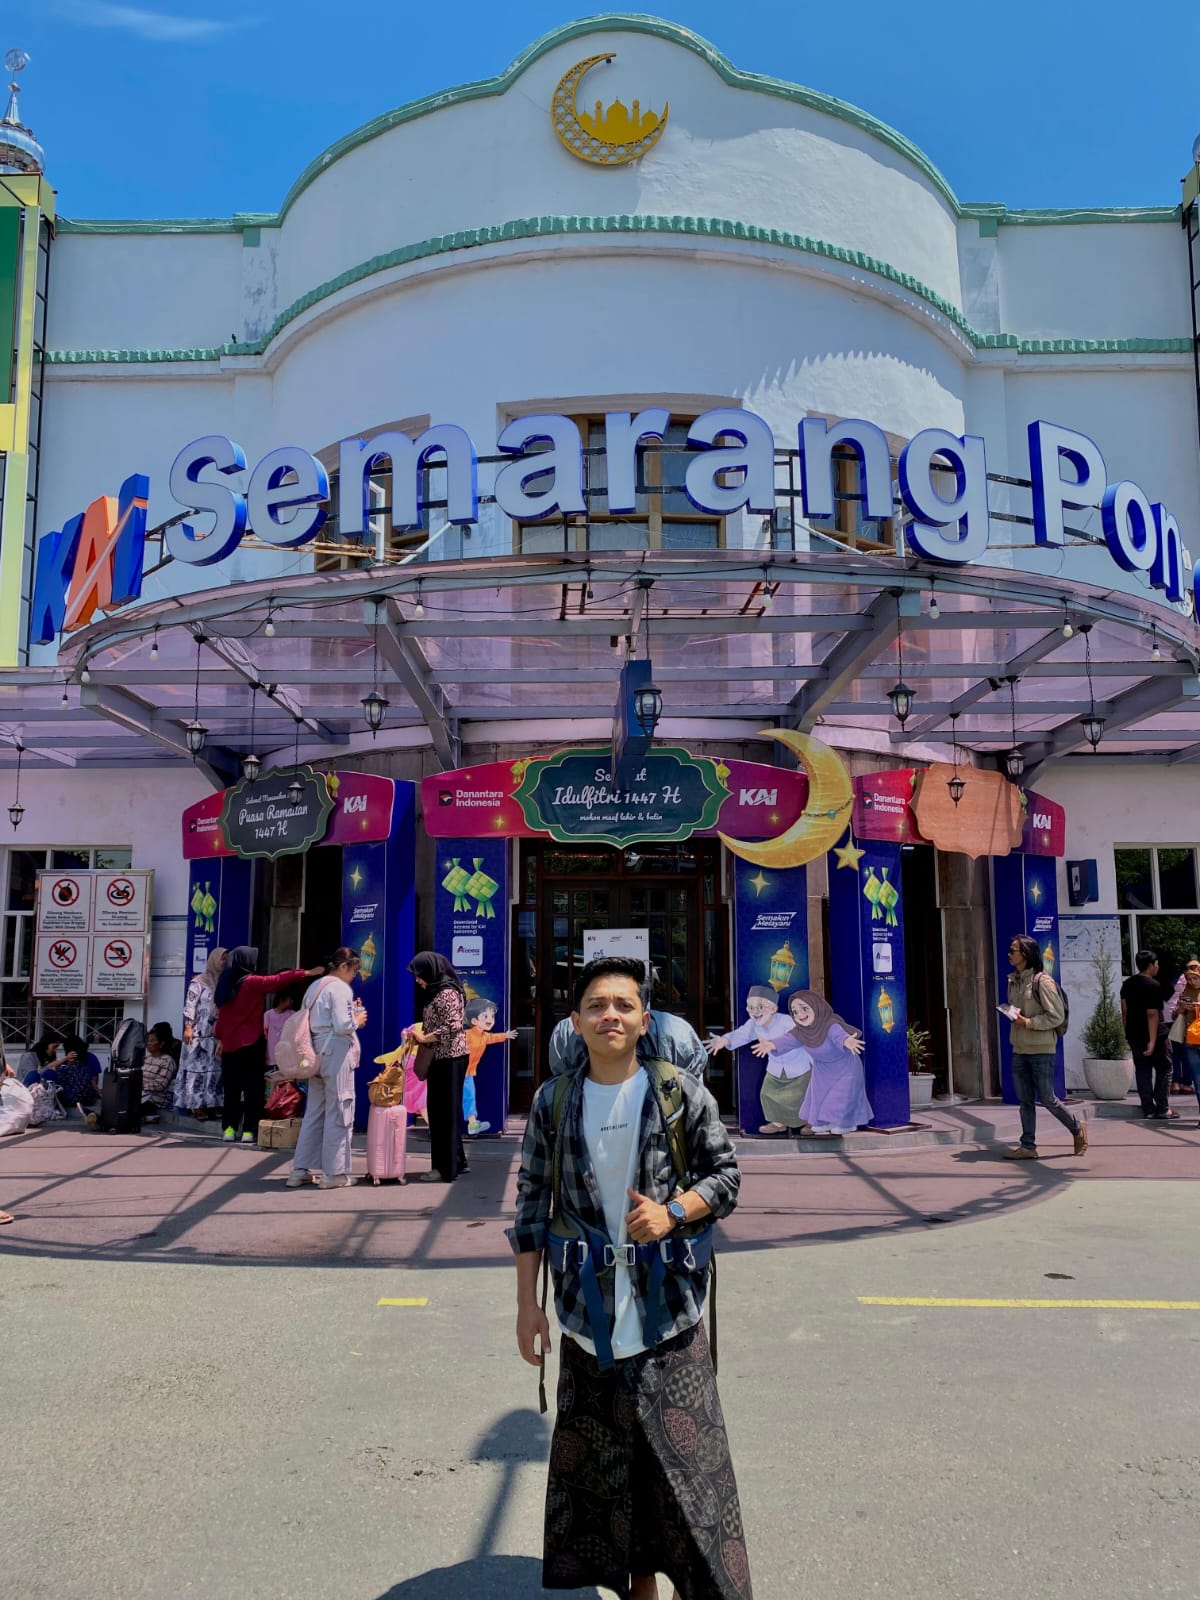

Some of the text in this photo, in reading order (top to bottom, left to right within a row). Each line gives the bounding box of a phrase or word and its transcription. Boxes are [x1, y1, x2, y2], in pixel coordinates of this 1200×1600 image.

[30, 407, 1200, 645] KAI Semarang Pon
[456, 789, 504, 799] Danantara
[552, 785, 682, 810] Idulfitri 1447 H
[740, 788, 777, 806] KAI
[874, 792, 906, 805] Danantara
[343, 795, 368, 814] KAI
[456, 798, 501, 808] Indonesia
[874, 802, 904, 814] Indonesia
[238, 808, 264, 826] Puasa
[1033, 813, 1051, 830] KAI
[255, 820, 288, 840] 1447 H
[757, 920, 791, 928] Melayani
